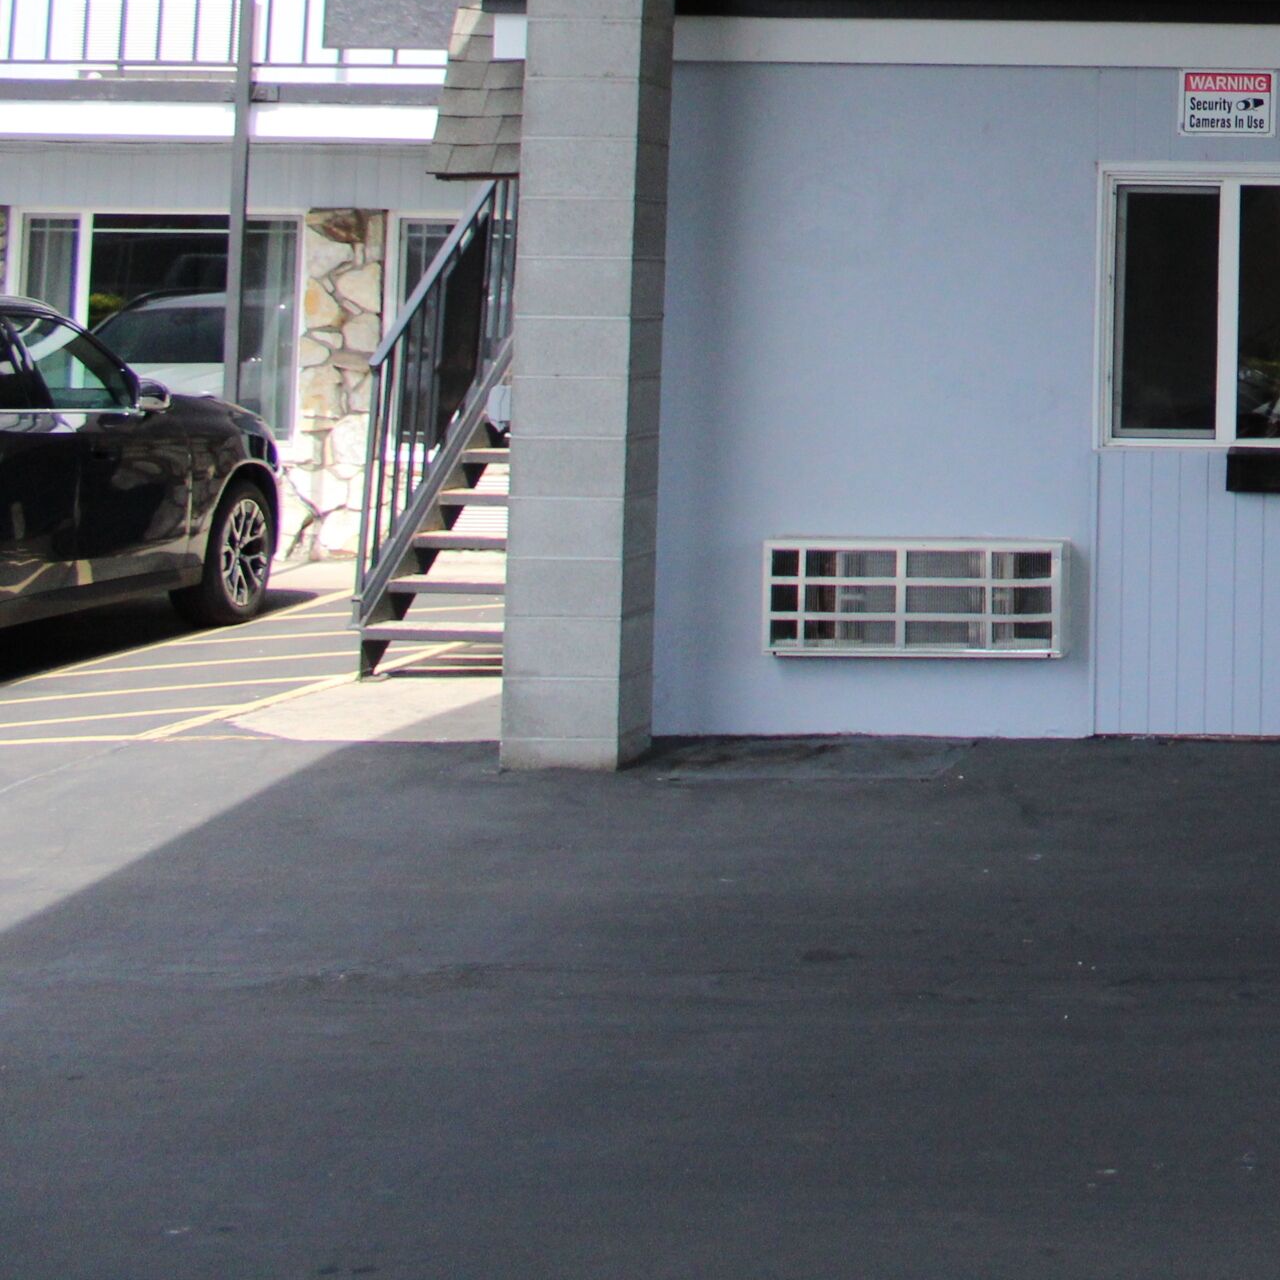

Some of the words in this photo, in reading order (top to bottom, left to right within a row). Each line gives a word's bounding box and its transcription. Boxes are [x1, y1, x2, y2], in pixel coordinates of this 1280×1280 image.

[1190, 76, 1267, 91] WARNING
[1190, 97, 1232, 114] Security
[1189, 114, 1231, 129] Cameras
[1235, 115, 1244, 129] In
[1247, 115, 1264, 129] Use
